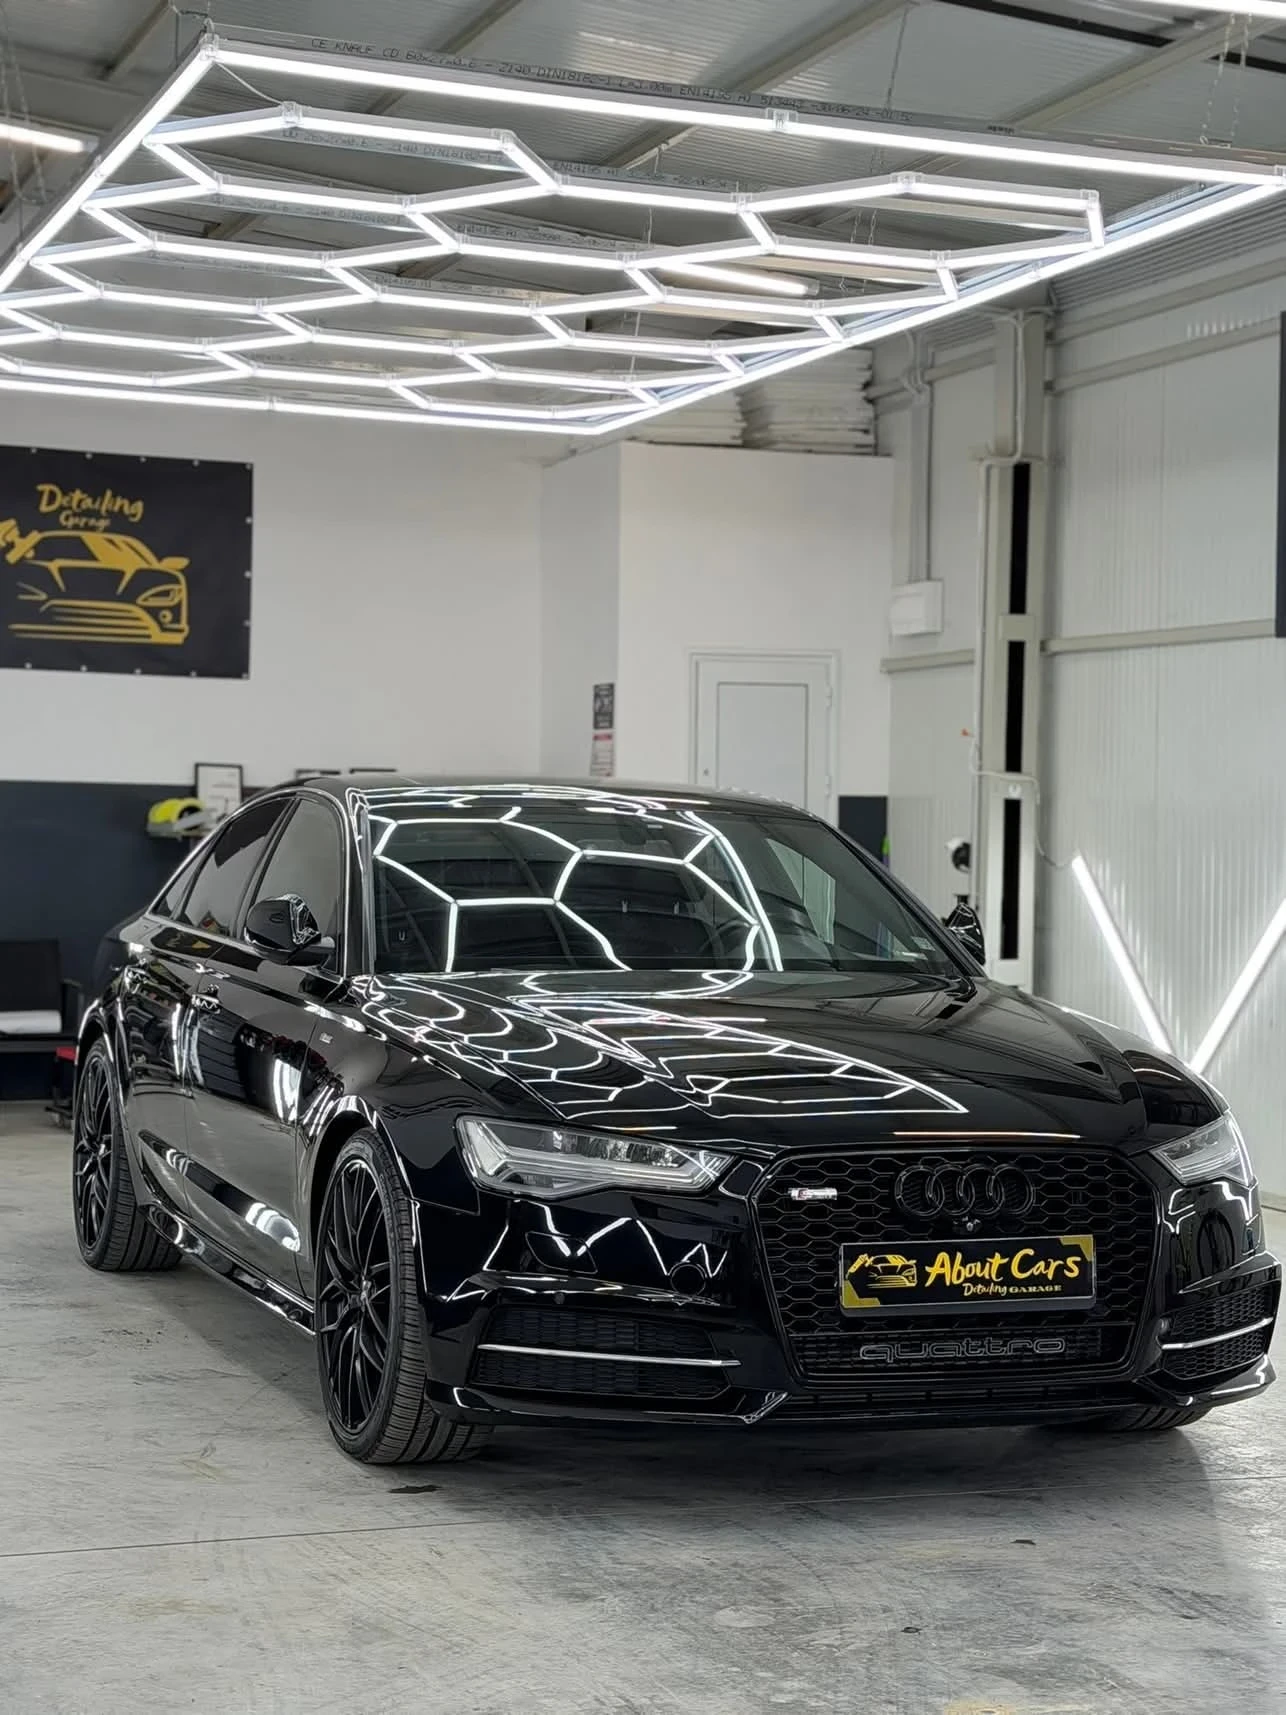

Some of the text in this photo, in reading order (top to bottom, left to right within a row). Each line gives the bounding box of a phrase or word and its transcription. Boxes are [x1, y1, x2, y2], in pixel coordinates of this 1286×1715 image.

[311, 38, 327, 49] CE
[383, 48, 400, 58] CD
[36, 483, 144, 522] Detailing
[924, 1248, 1081, 1287] About Cars
[962, 1282, 1062, 1296] Detailing GARAGE
[860, 1337, 1066, 1363] quattro
